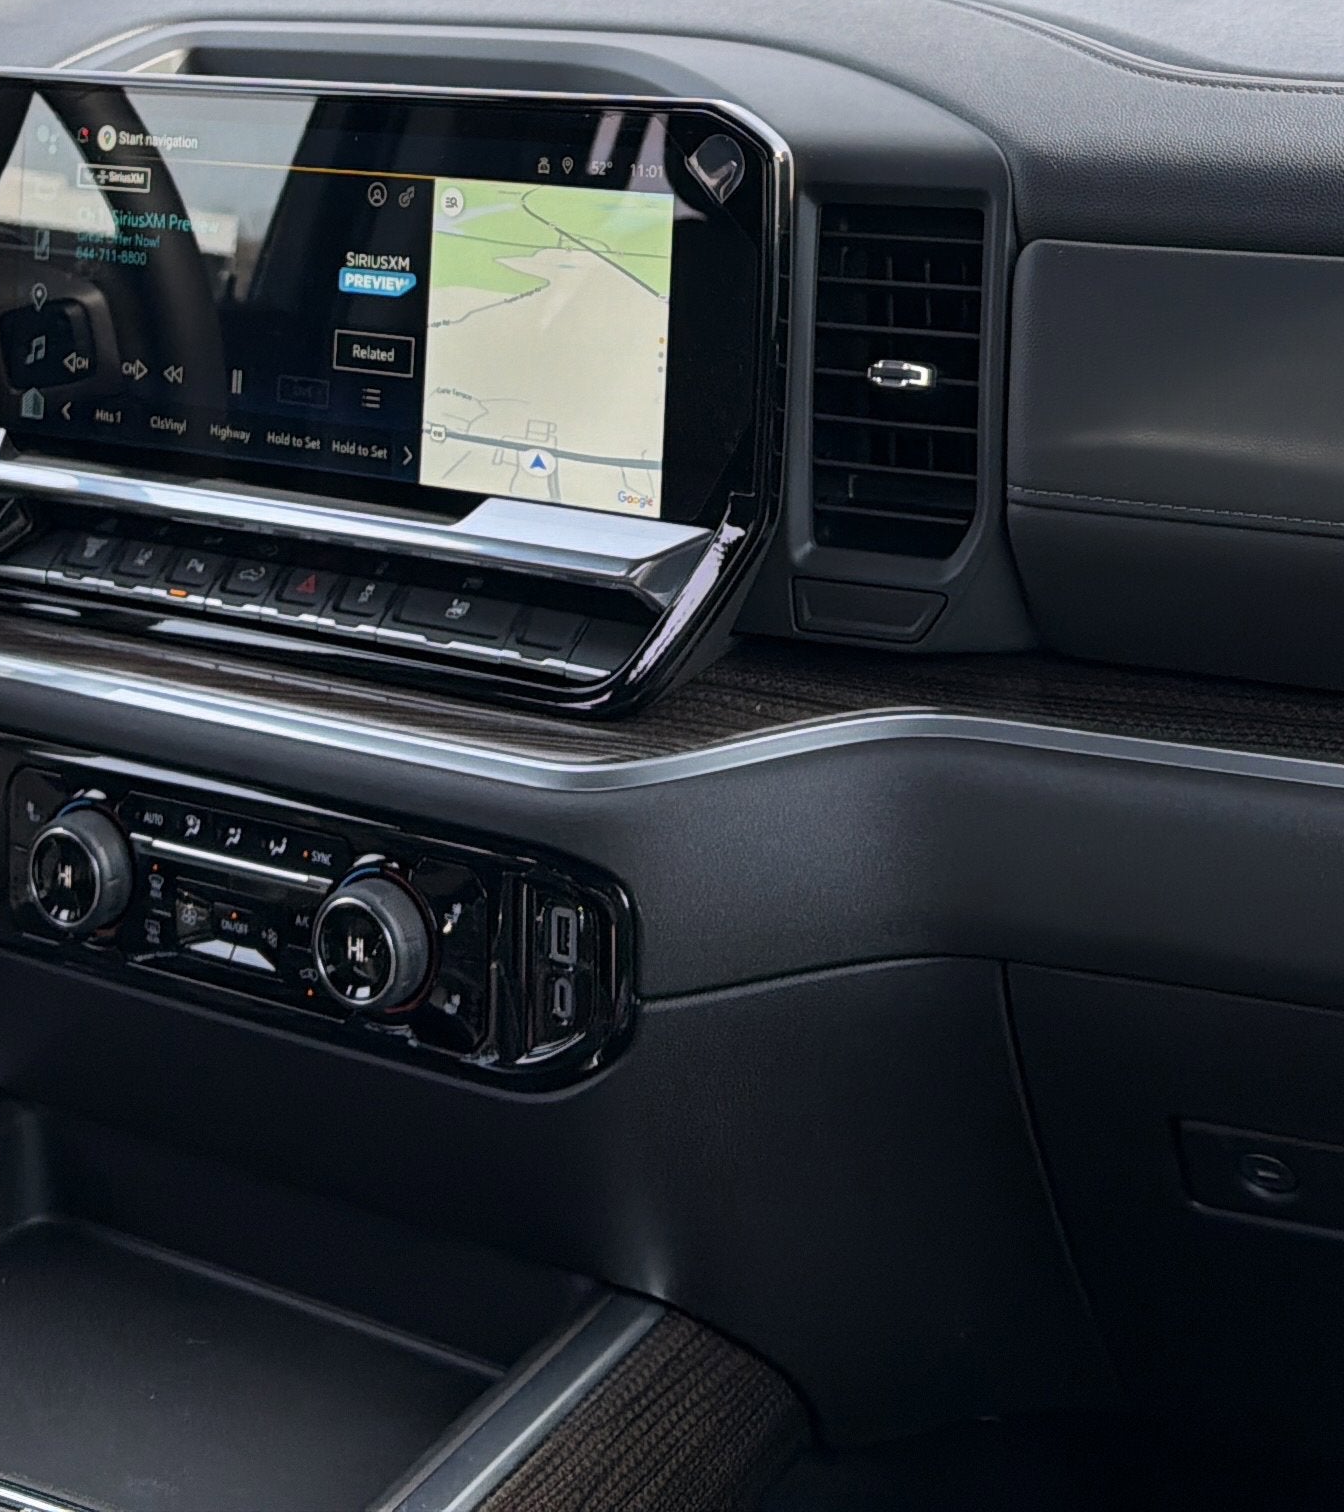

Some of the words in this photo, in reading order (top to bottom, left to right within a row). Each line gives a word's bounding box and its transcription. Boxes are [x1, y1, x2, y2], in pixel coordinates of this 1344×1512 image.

[118, 131, 143, 146] Start
[145, 133, 198, 149] navigation
[630, 163, 664, 179] 11:01
[113, 210, 166, 230] SiriusXM
[346, 252, 410, 270] SIRIUSXM
[345, 273, 410, 291] PREVIEW
[352, 344, 395, 362] Related
[76, 357, 89, 369] CH
[122, 362, 136, 376] CH
[95, 409, 114, 422] Hits
[210, 424, 251, 444] Highway
[267, 430, 290, 446] Hold
[292, 434, 303, 447] to
[305, 435, 321, 450] Set
[332, 440, 356, 456] Hold
[358, 444, 369, 457] to
[369, 445, 388, 460] Set
[617, 490, 654, 508] Google
[143, 812, 164, 827] AUTO
[311, 850, 333, 866] SYNC
[58, 864, 72, 888] HI
[221, 919, 249, 935] ON/OFF
[295, 913, 310, 928] A/C
[347, 936, 364, 963] HI
